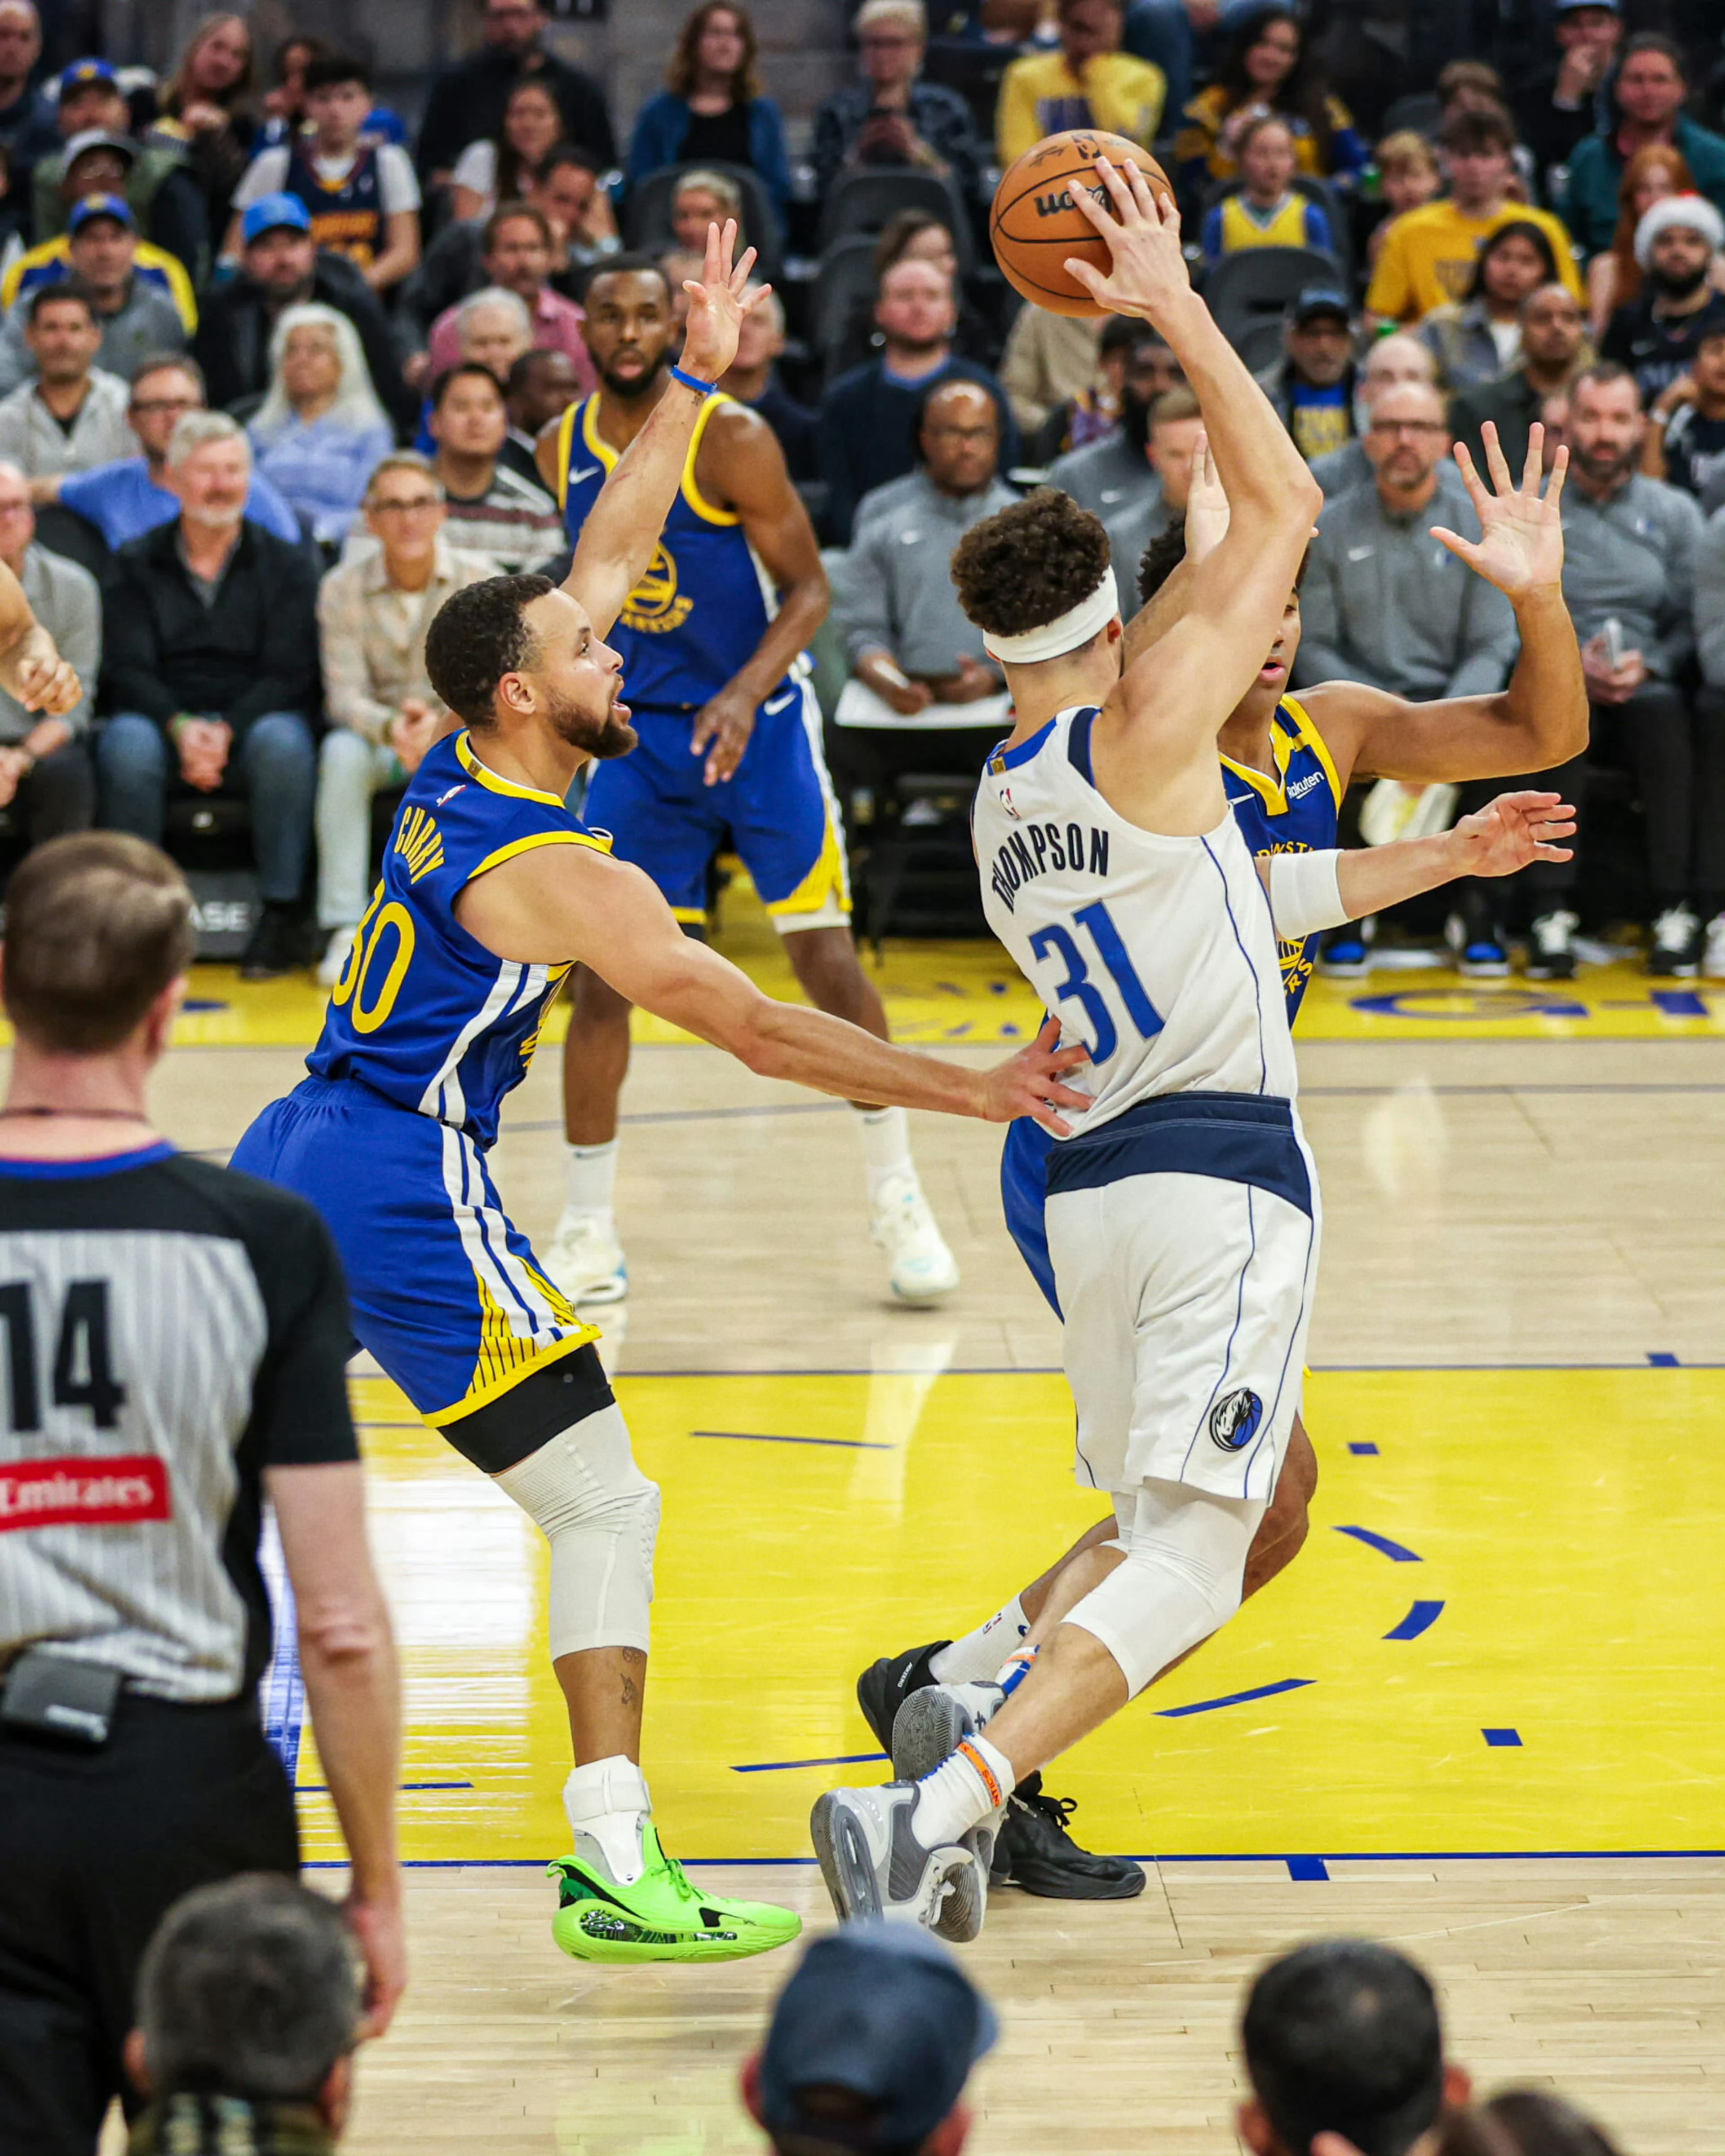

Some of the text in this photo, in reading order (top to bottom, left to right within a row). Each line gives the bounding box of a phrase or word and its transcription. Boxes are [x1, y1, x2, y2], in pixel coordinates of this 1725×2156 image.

[1286, 771, 1325, 799] Rakuten
[394, 806, 444, 884] CURRY
[992, 823, 1108, 915] THOMPSON
[187, 901, 248, 932] ASE
[332, 878, 415, 1034] 30
[1027, 898, 1166, 1067] 31
[0, 1281, 128, 1430] 14
